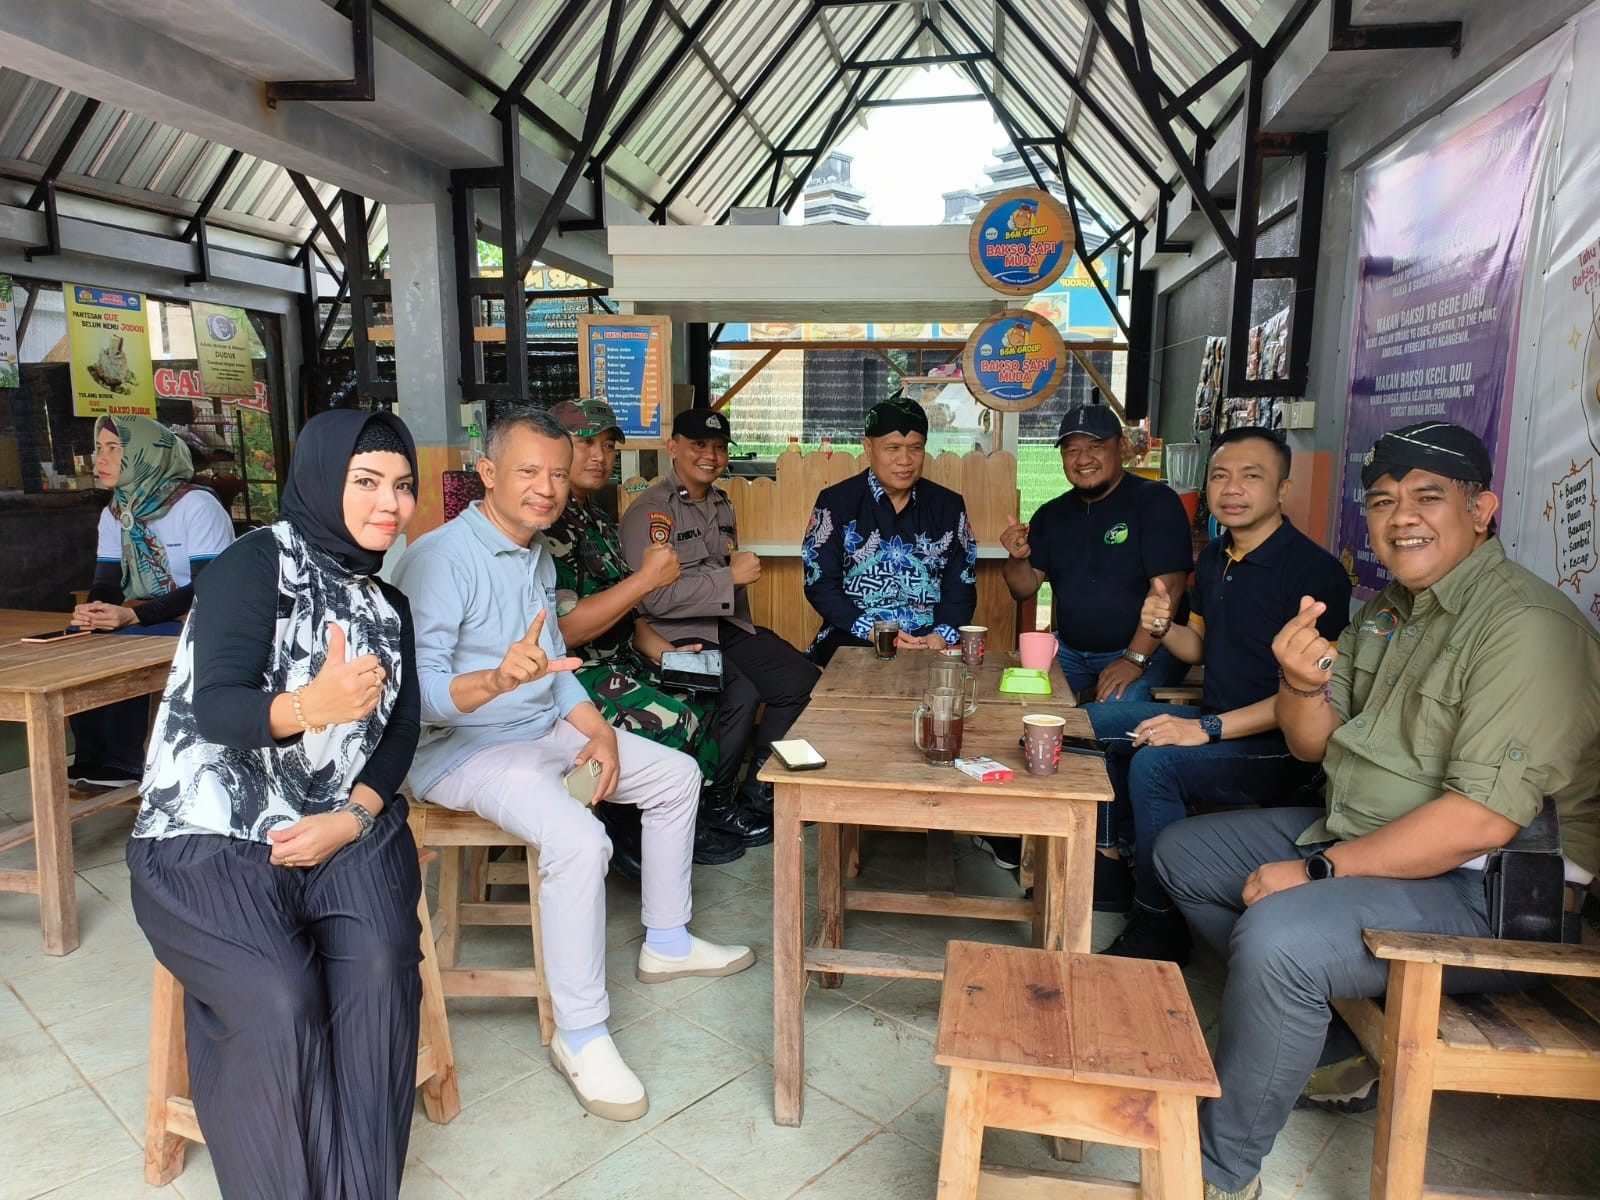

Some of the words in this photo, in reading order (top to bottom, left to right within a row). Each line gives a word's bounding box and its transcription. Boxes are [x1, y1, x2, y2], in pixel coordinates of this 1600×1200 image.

[1023, 226, 1048, 236] GROUP
[986, 244, 1026, 257] BAKSO
[1028, 241, 1056, 254] SAPI
[1004, 255, 1038, 268] MUDA
[1572, 265, 1595, 291] Bakso
[72, 310, 102, 320] PANTESAN
[103, 313, 120, 322] GUE
[1376, 312, 1400, 334] MAKAN
[1400, 305, 1424, 328] BAKSO
[1426, 302, 1437, 320] YG
[1438, 295, 1460, 317] GEDE
[1462, 287, 1486, 311] DULU
[120, 323, 144, 333] JODOH
[1017, 344, 1041, 355] GROUP
[981, 360, 1020, 372] BAKSO
[1022, 360, 1050, 371] SAPI
[998, 371, 1032, 383] MUDA
[1375, 373, 1399, 392] MAKAN
[1400, 369, 1424, 388] BAKSO
[1425, 365, 1447, 386] KECIL
[1449, 362, 1472, 383] DULU
[1565, 478, 1587, 498] Bawang
[1568, 520, 1592, 538] Bawang
